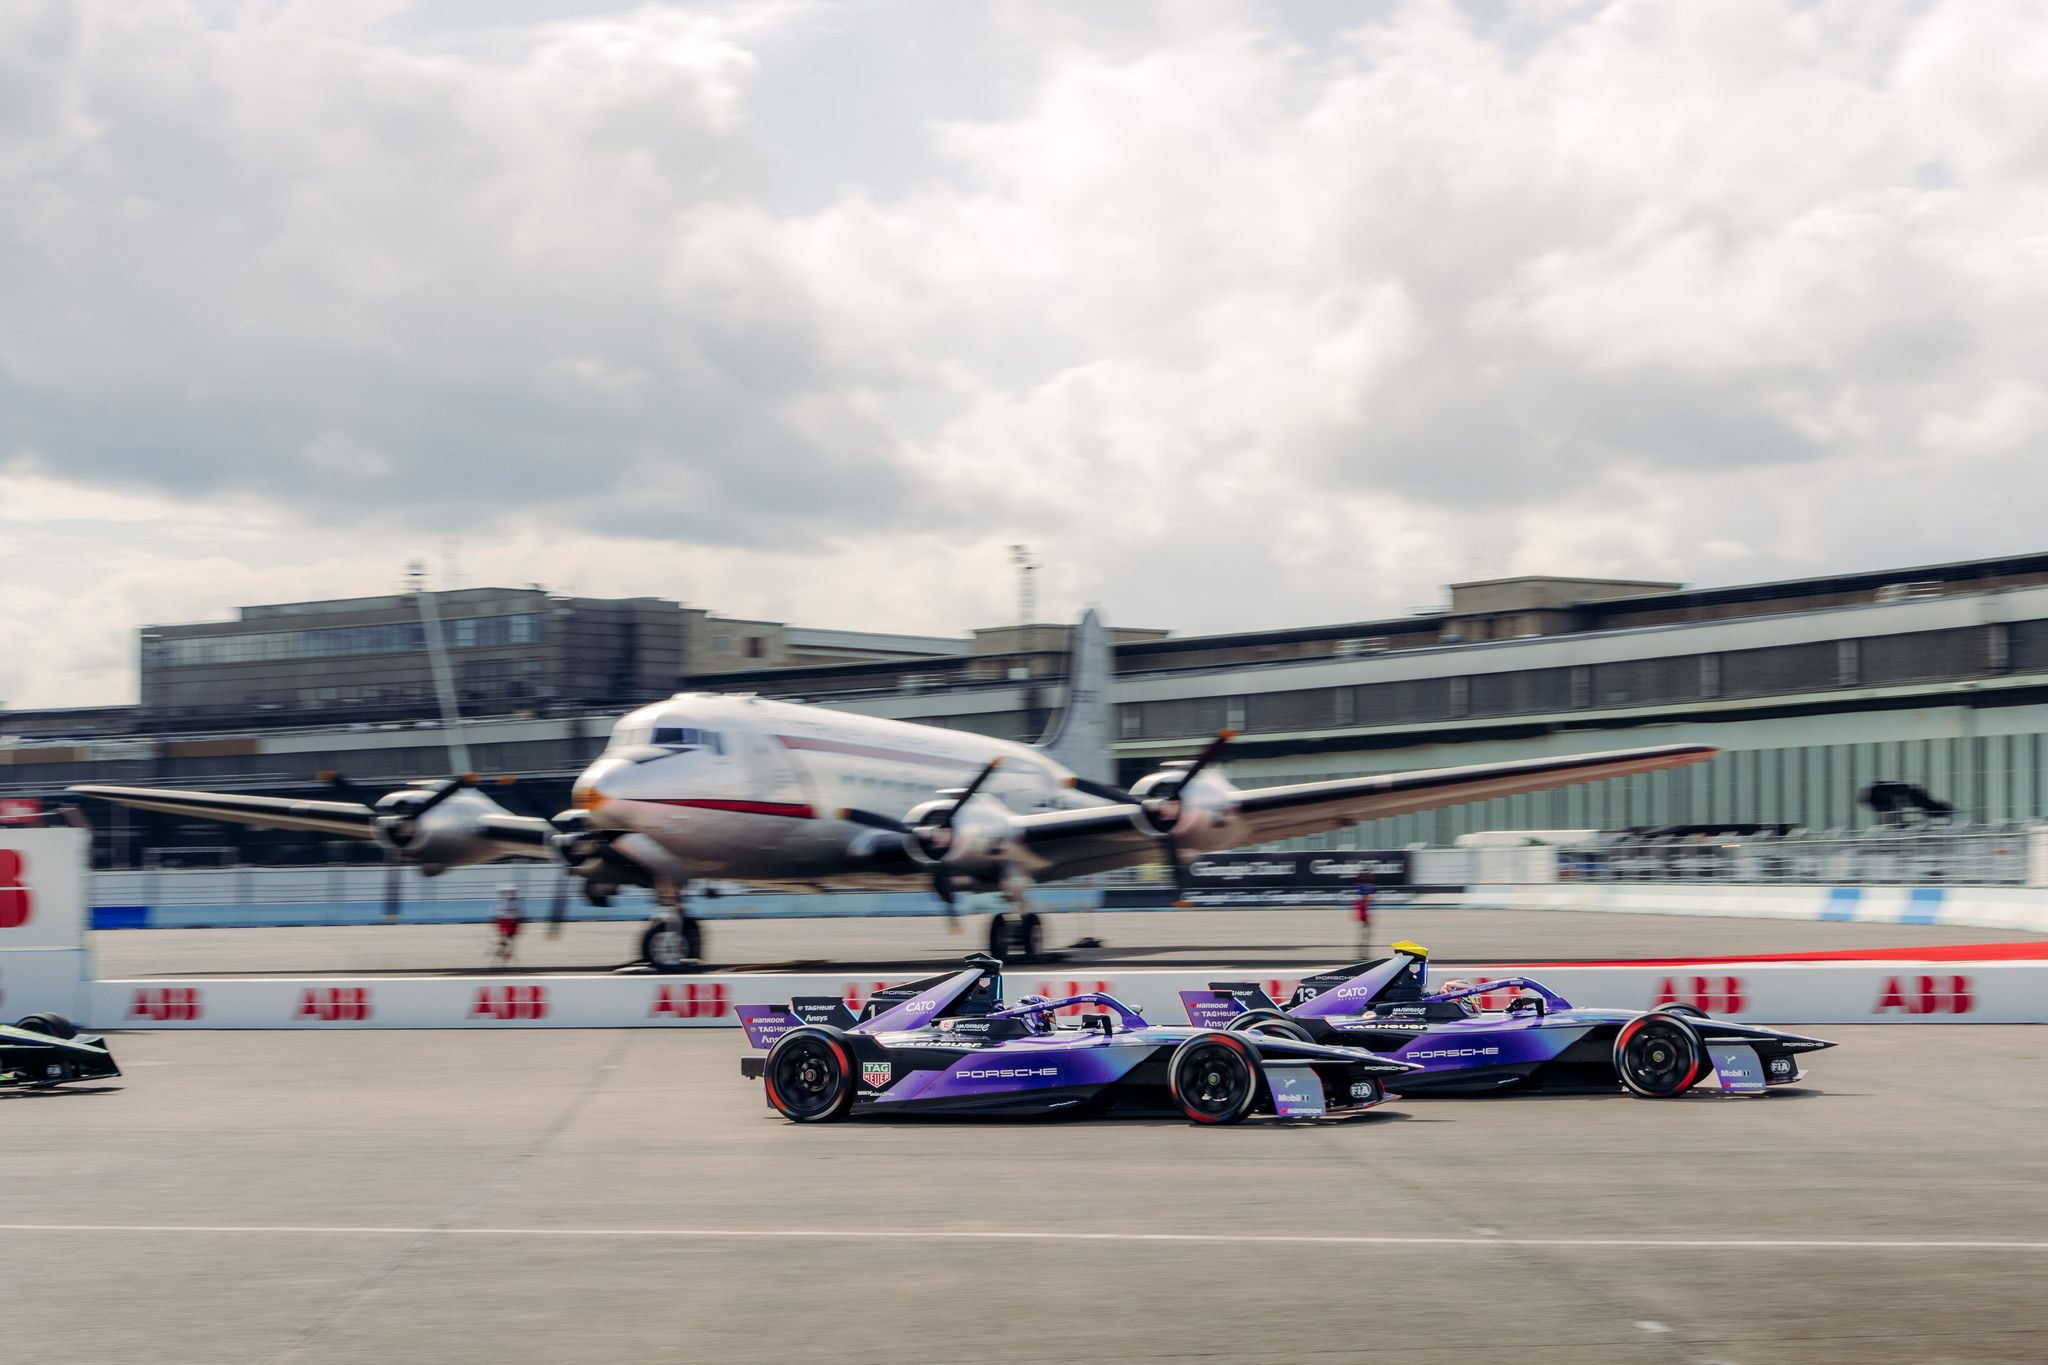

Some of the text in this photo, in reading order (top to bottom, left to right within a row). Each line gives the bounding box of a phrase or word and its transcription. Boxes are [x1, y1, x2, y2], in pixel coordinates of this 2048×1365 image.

[1297, 988, 1317, 1002] 13
[1337, 987, 1368, 998] CATO
[1652, 976, 1748, 1014] ABB
[1873, 976, 1977, 1014] ABB
[126, 988, 202, 1020] ABB
[293, 988, 373, 1020] ABB
[467, 986, 547, 1019] ABB
[647, 984, 732, 1018] ABB
[905, 1000, 936, 1012] CATO
[805, 1014, 828, 1022] Ansys
[868, 1004, 876, 1018] 1
[1406, 1047, 1499, 1059] PORSCHE
[865, 1064, 889, 1072] TAG
[956, 1068, 1058, 1079] PORSCHE
[864, 1073, 889, 1086] HEUER
